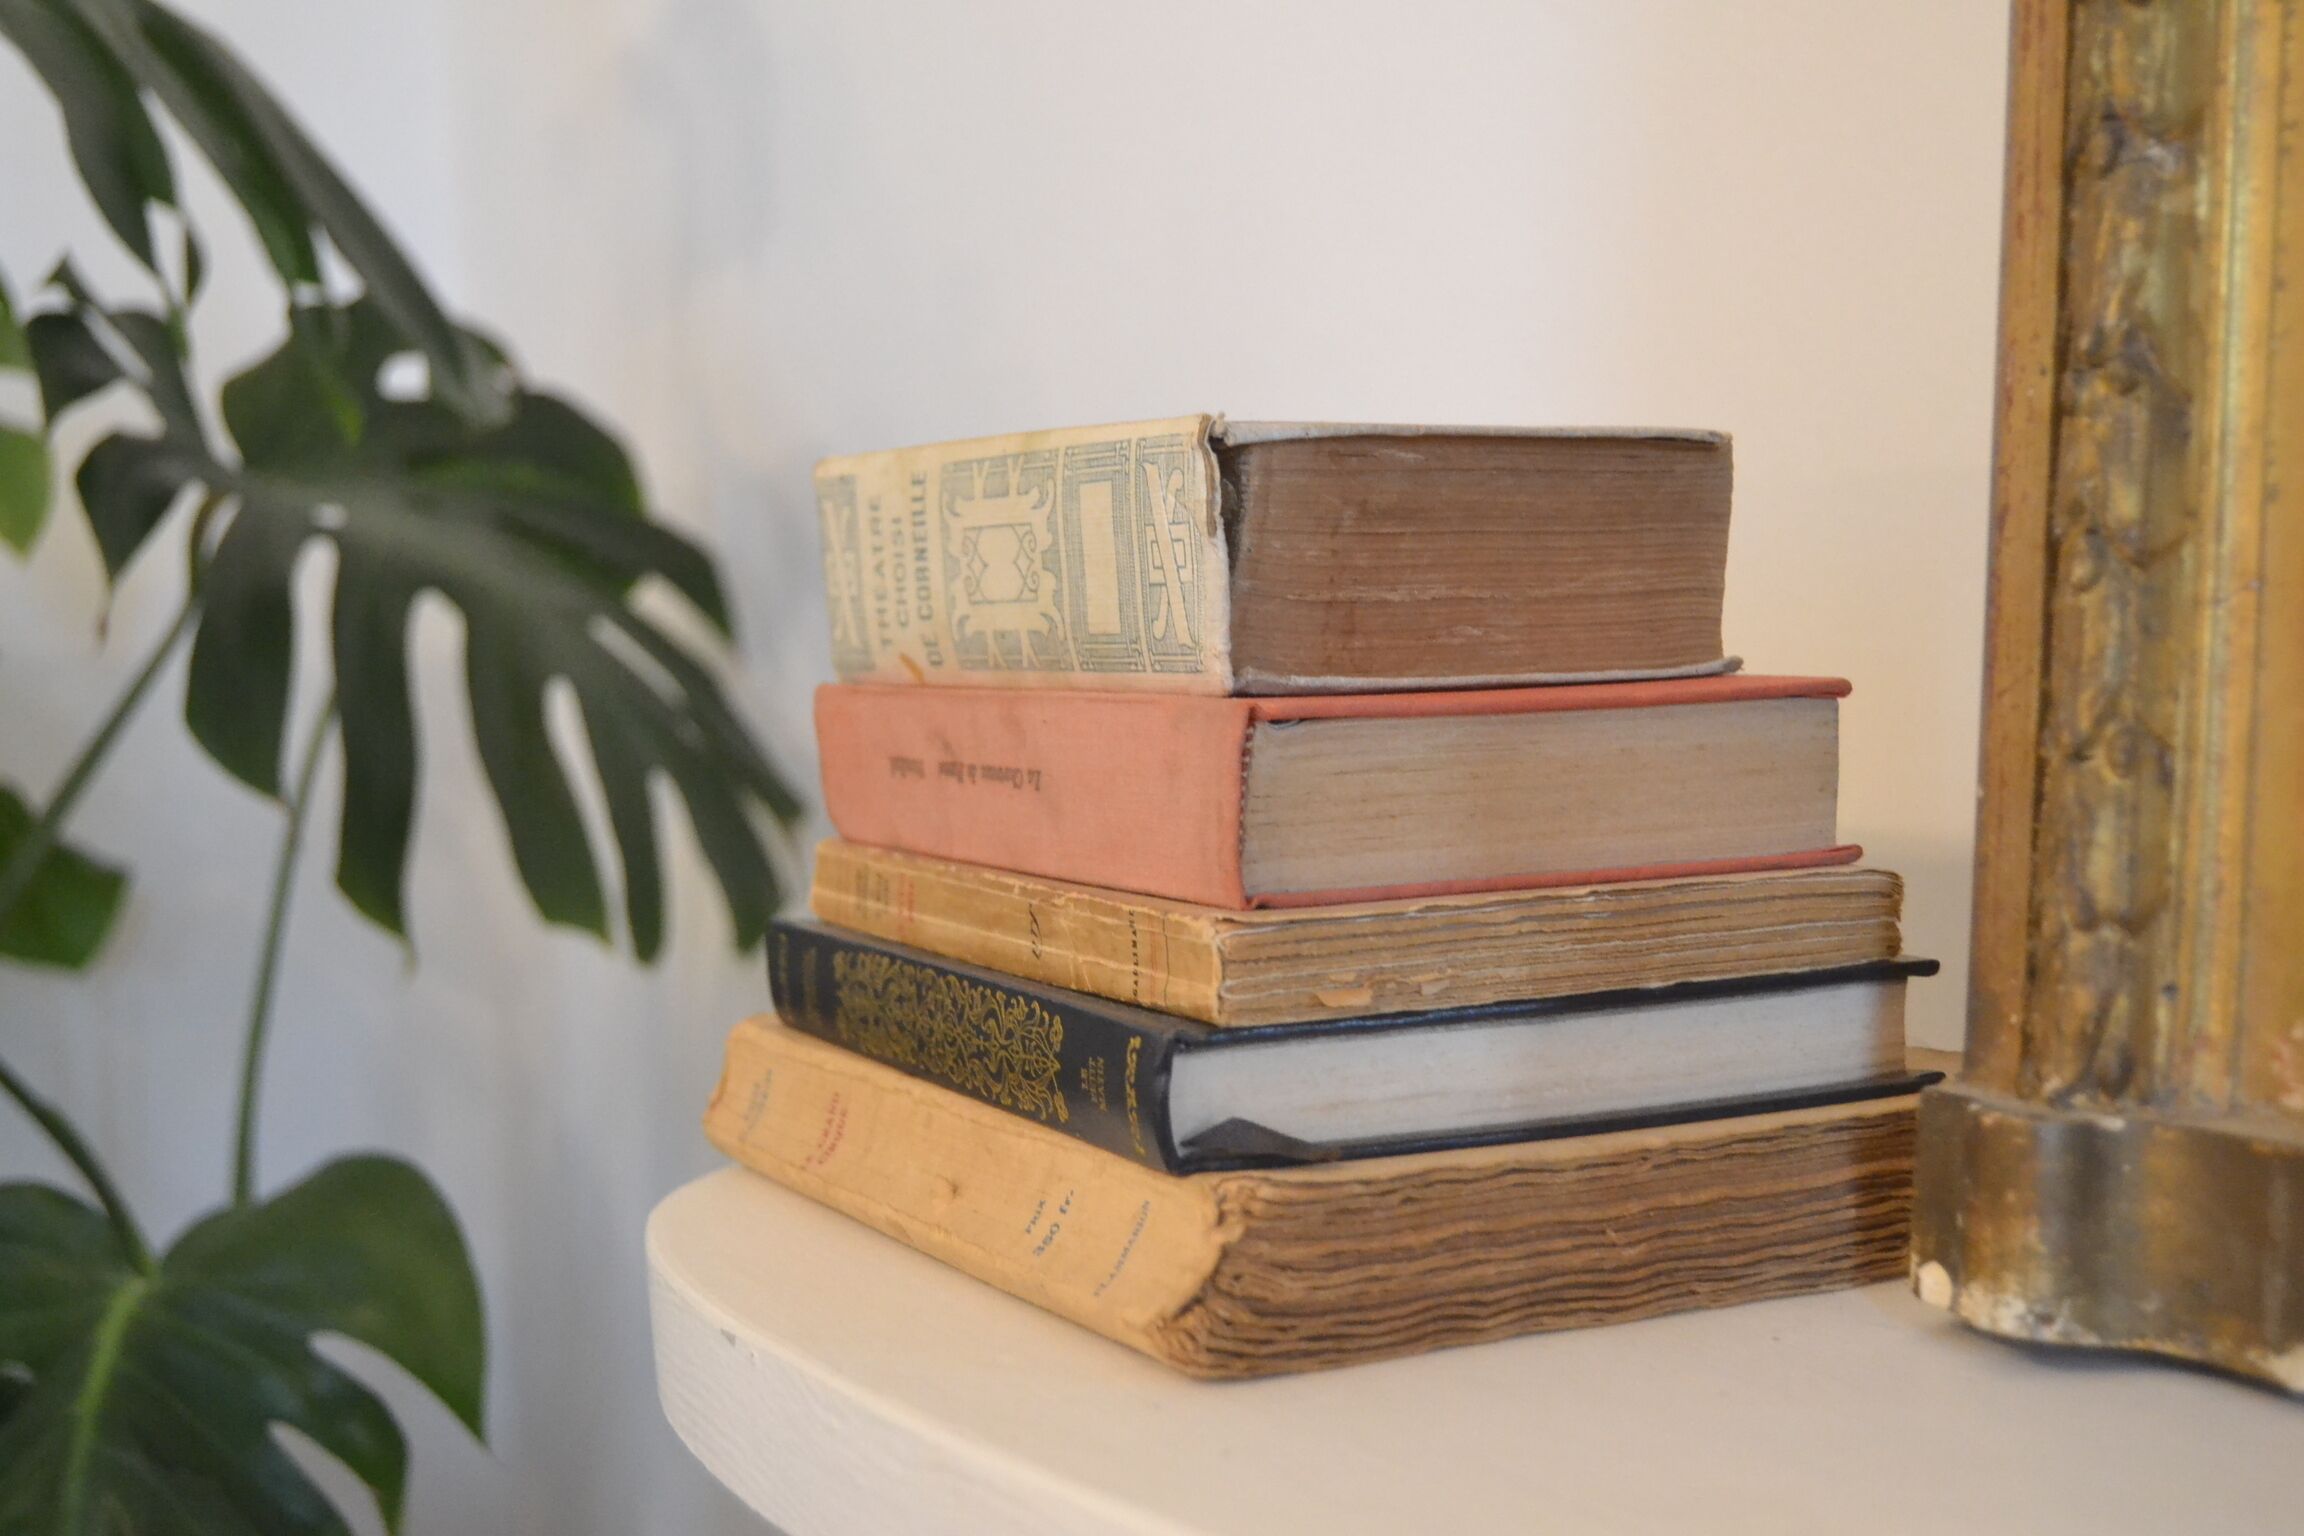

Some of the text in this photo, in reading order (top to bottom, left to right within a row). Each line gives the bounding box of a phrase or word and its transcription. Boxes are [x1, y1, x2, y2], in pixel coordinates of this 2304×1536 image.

[890, 516, 909, 630] CHOISI
[911, 469, 944, 668] DE CORNEILLE
